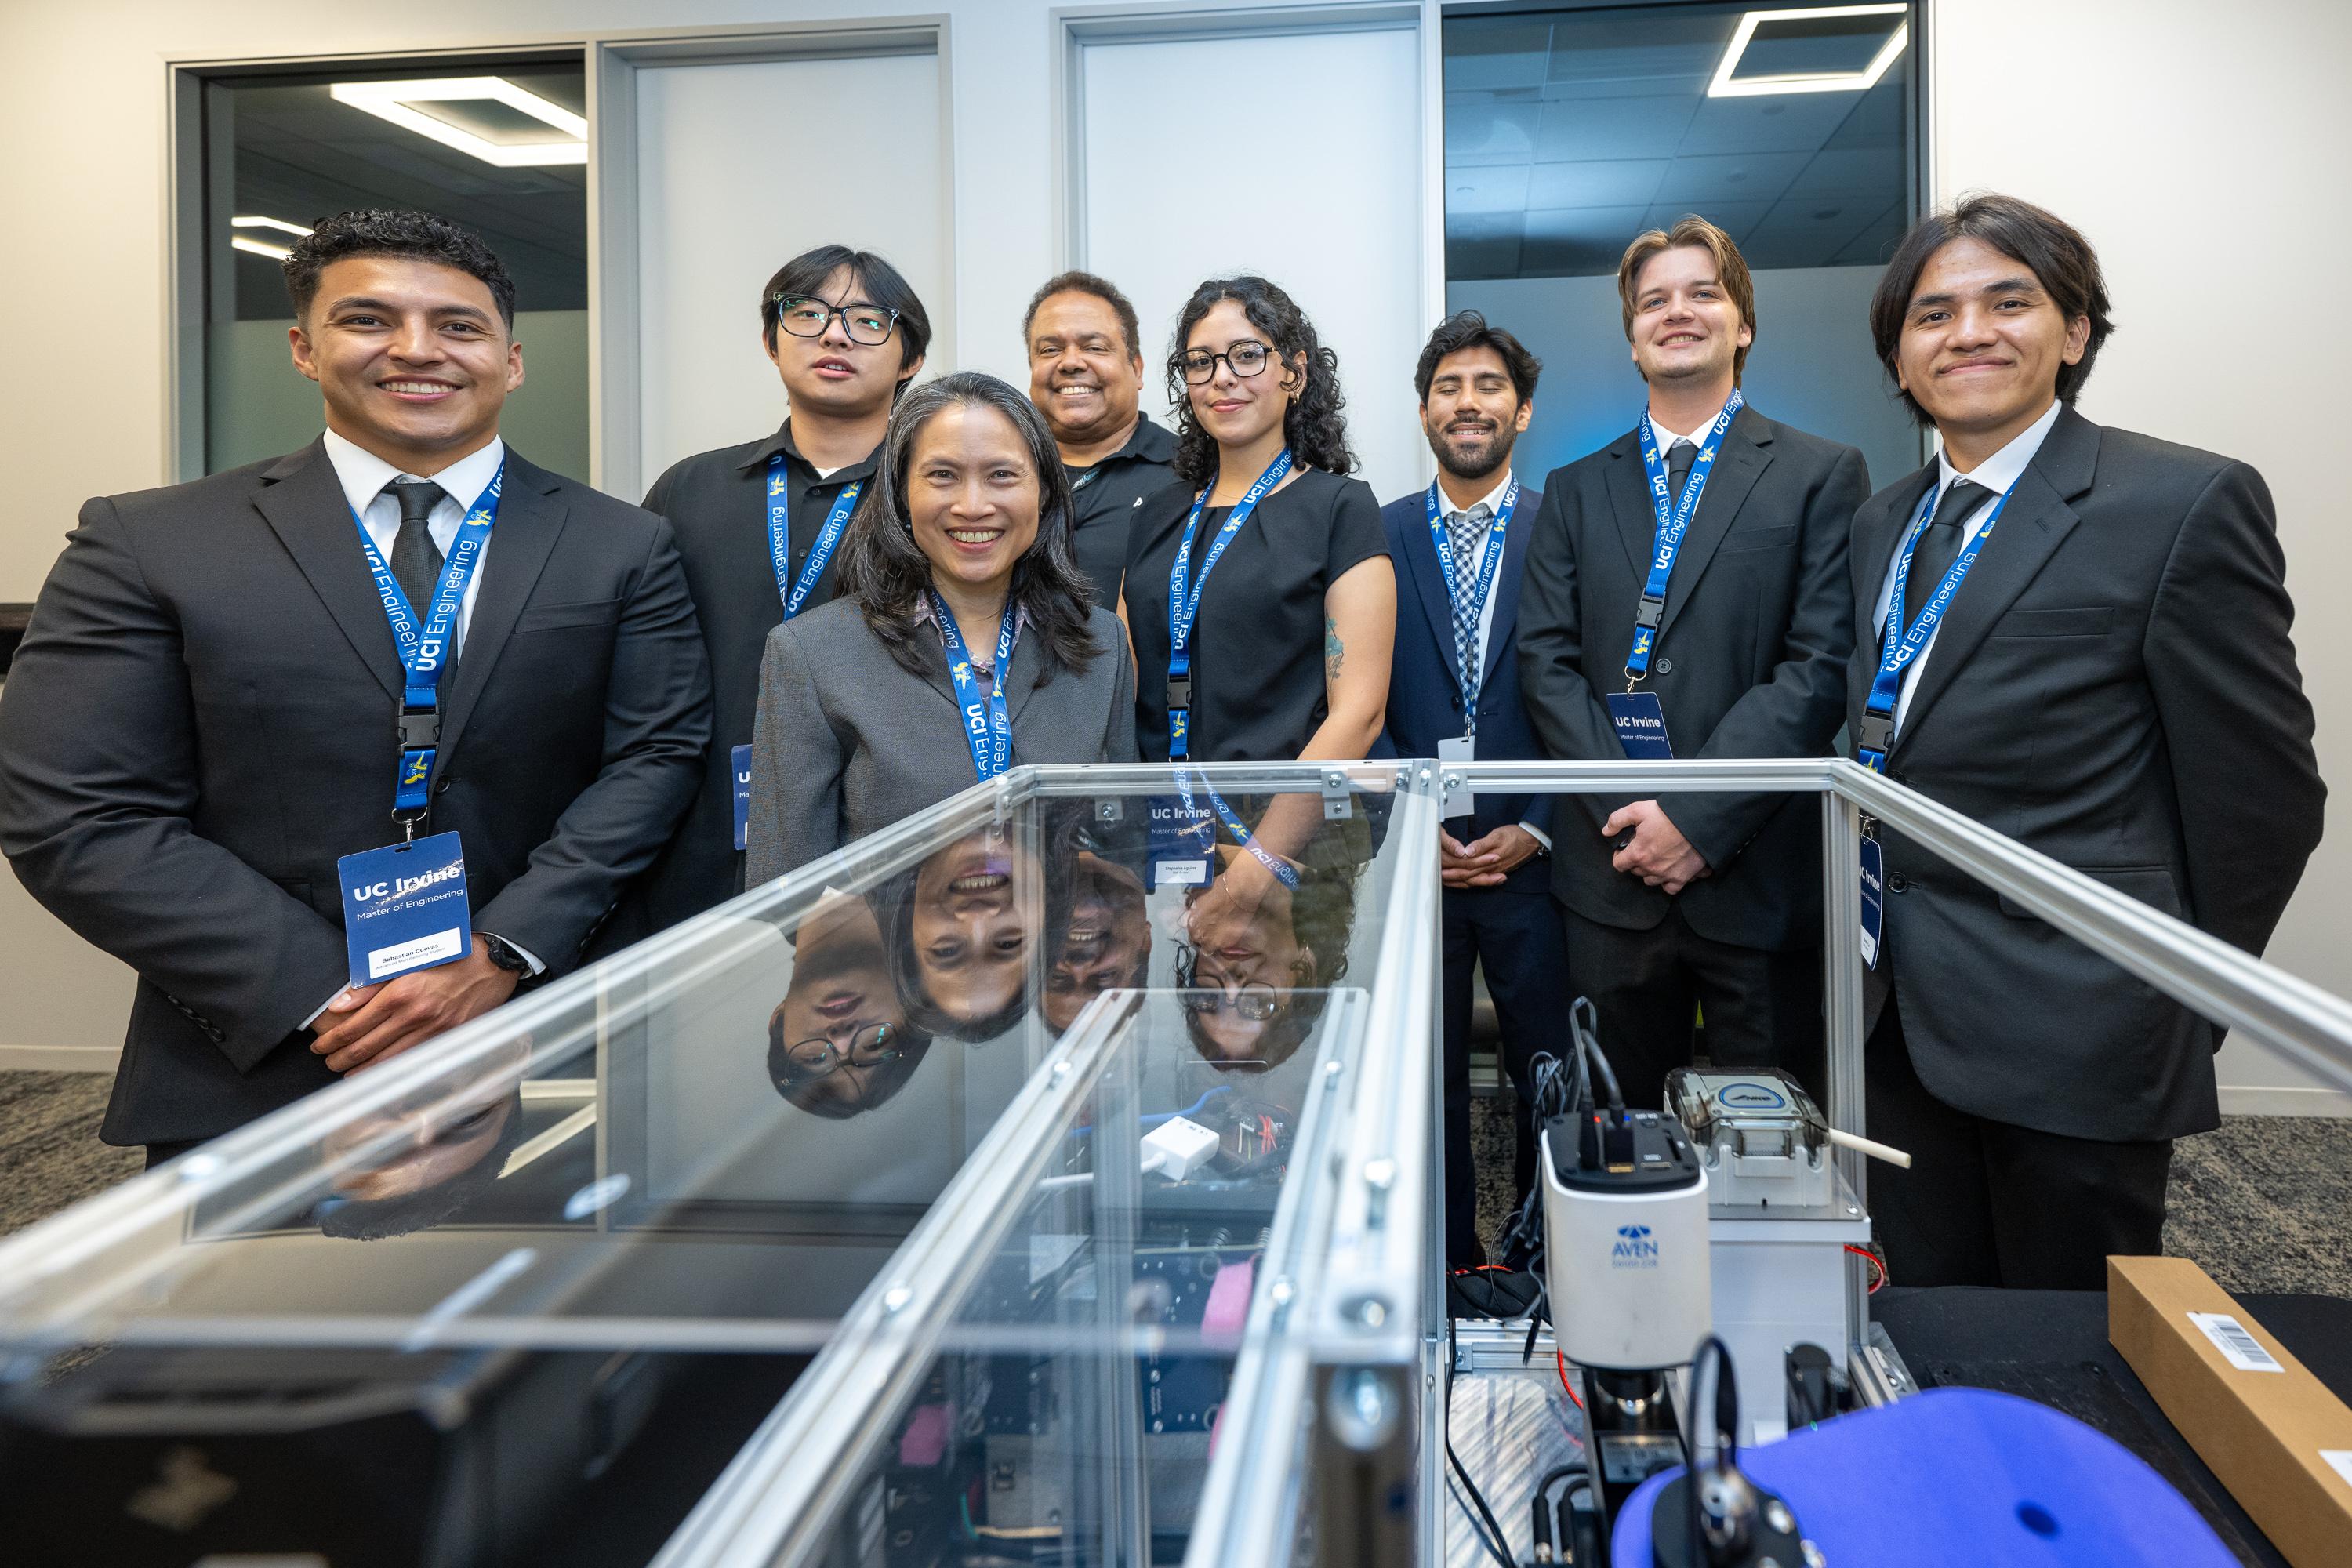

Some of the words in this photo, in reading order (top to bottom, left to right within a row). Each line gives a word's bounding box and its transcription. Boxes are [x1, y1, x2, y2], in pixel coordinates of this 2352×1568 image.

[1713, 412, 1731, 435] UCI
[1243, 484, 1266, 504] UCI
[1502, 490, 1517, 507] UCI
[1653, 474, 1668, 496] UCI
[1664, 472, 1704, 544] Engineering
[788, 586, 808, 612] UCI
[801, 510, 848, 586] Engineering
[1178, 539, 1191, 564] UCI
[1438, 542, 1452, 563] UCI
[1655, 545, 1674, 570] UCI
[1897, 552, 1913, 581] UCI
[426, 539, 477, 636] Engineering
[1174, 623, 1189, 650] UCI
[1182, 542, 1225, 620] Engineering
[1469, 607, 1480, 629] UCI
[1475, 540, 1501, 606] Engineering
[1885, 644, 1915, 672] UCI
[1907, 551, 1977, 644] Engineering
[416, 638, 442, 672] UCI
[997, 630, 1011, 659] UCI
[967, 703, 988, 735] UCI
[1615, 717, 1632, 728] UC
[1632, 717, 1661, 728] Irvine
[739, 771, 750, 783] U
[1152, 808, 1171, 820] UC
[1174, 808, 1211, 819] Irvine
[354, 882, 390, 902] UC
[395, 866, 461, 892] Irvine
[357, 907, 391, 921] Master
[393, 903, 404, 912] of
[405, 889, 463, 909] Engineering
[381, 950, 414, 964] Sebastian
[415, 943, 439, 953] Cuevas
[1612, 1240, 1658, 1257] AVEN
